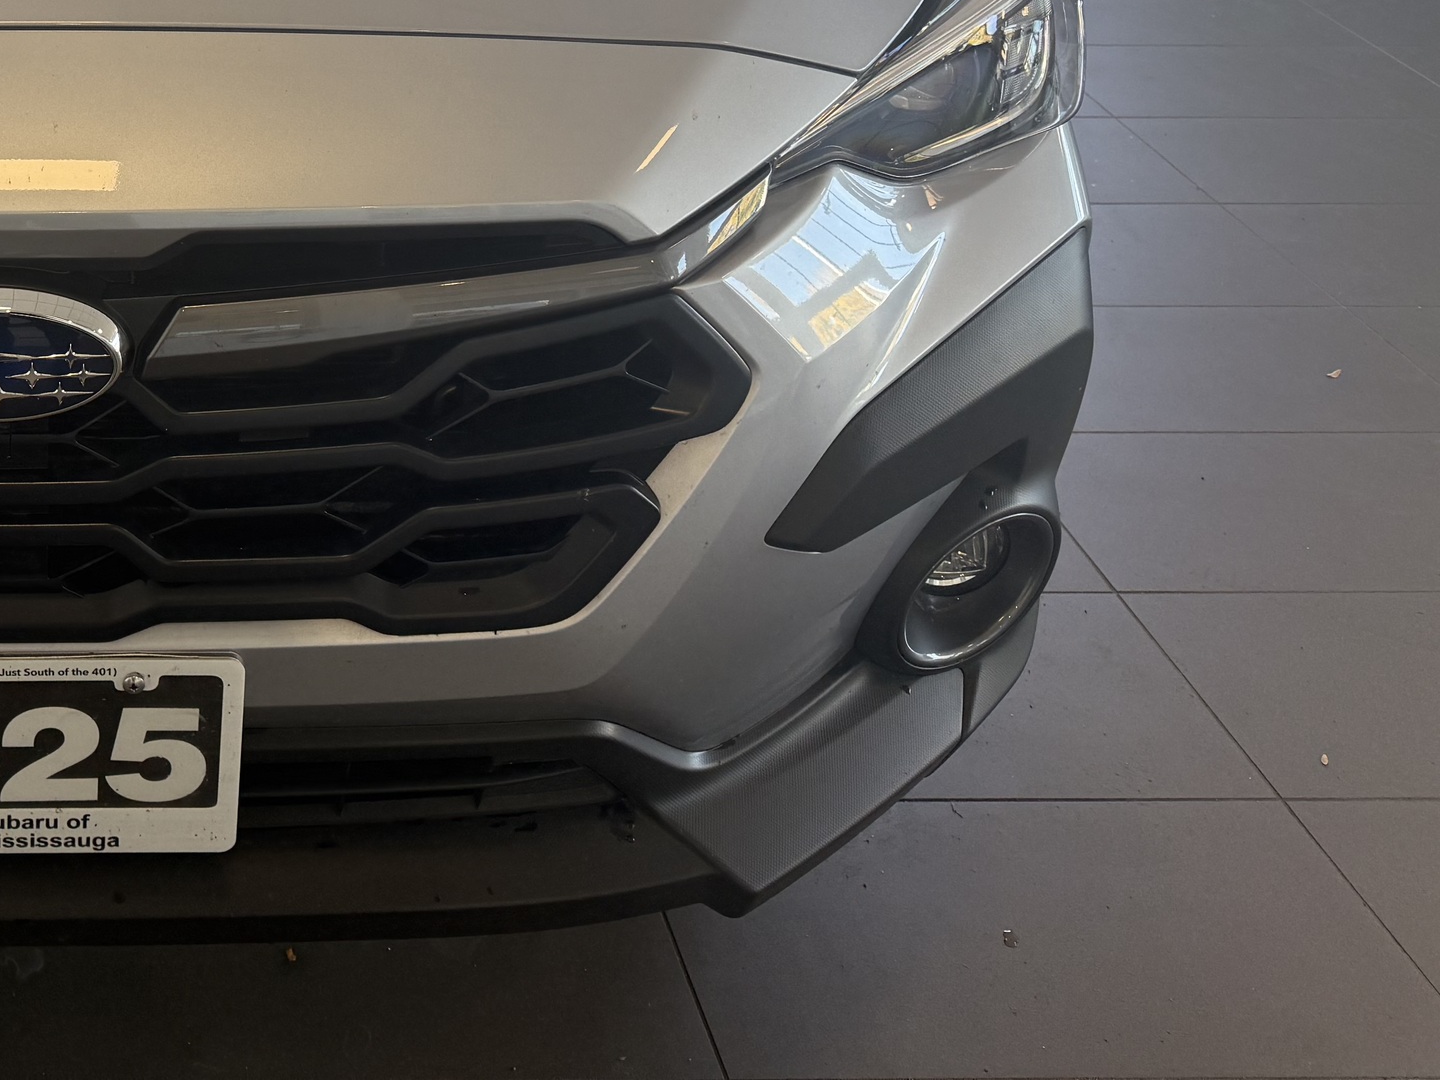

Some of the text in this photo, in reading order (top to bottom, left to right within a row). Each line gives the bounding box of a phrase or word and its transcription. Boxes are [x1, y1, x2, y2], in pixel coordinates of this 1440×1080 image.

[23, 668, 55, 677] South
[58, 668, 69, 677] of
[71, 668, 89, 677] the
[92, 667, 117, 677] 401)
[66, 815, 90, 829] of
